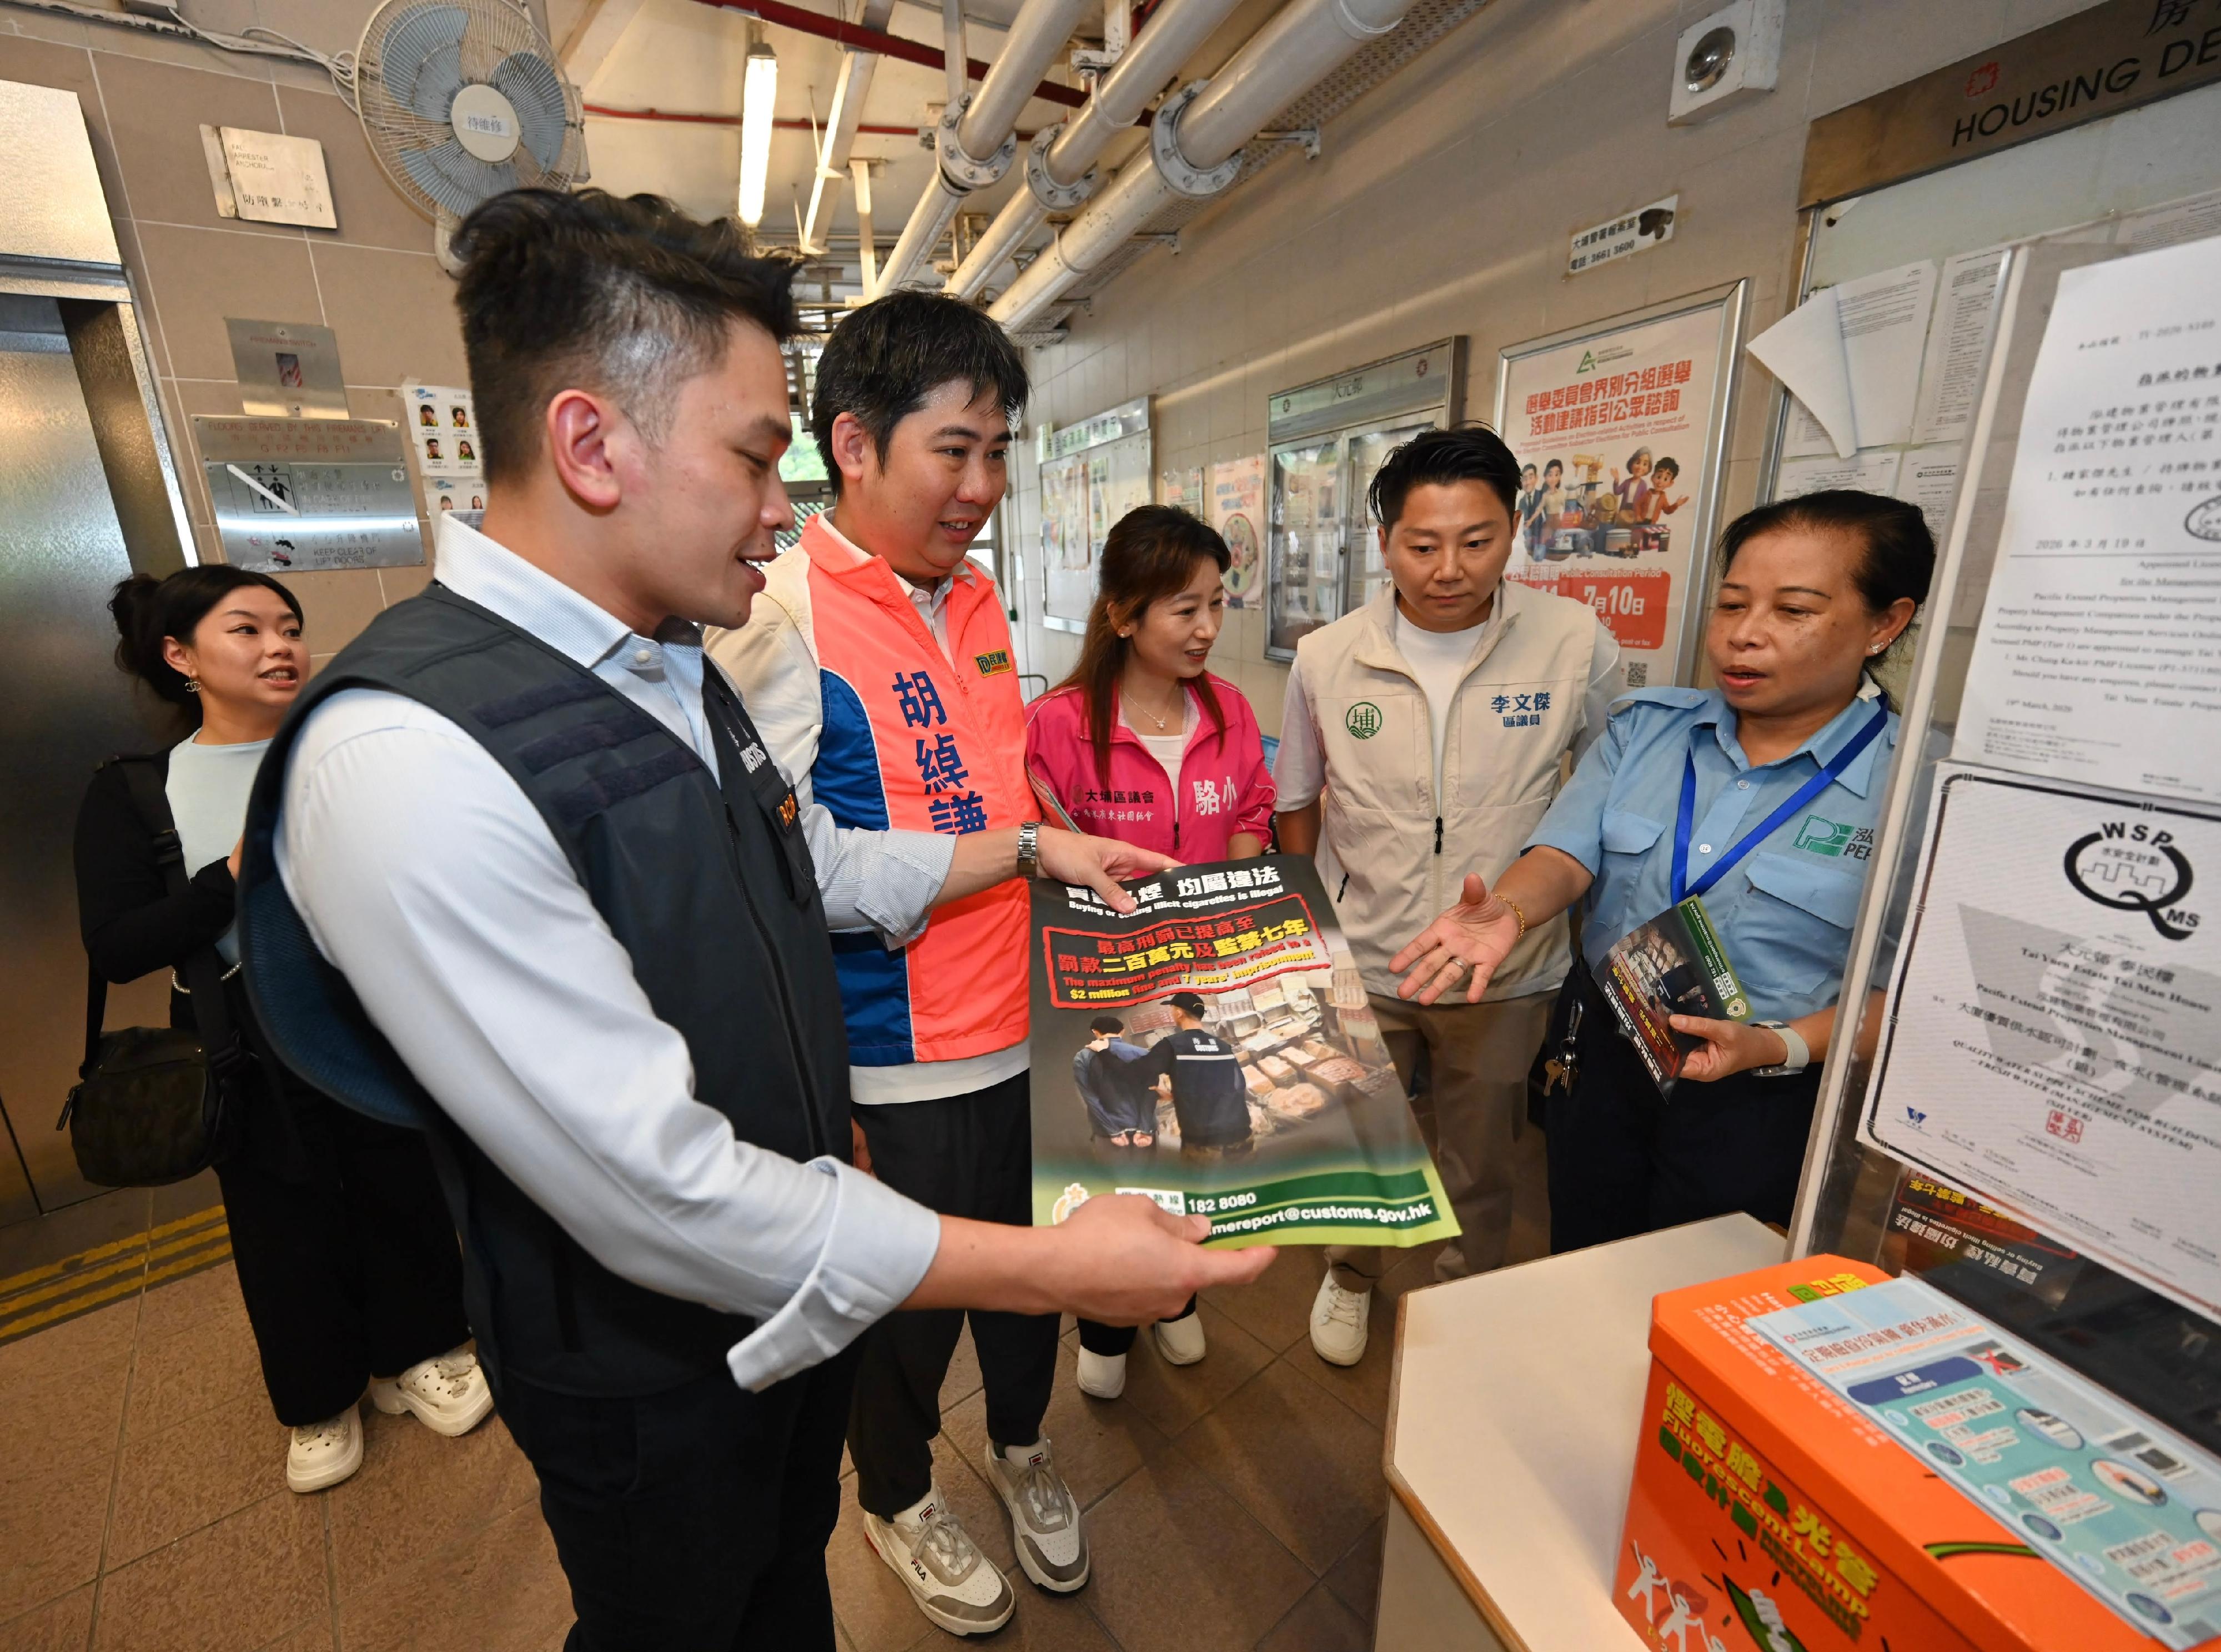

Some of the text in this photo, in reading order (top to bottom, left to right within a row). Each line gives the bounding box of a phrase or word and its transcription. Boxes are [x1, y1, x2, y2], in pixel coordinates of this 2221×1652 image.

[1952, 27, 2221, 148] HOUSING DE
[234, 153, 269, 162] ARRESTER
[1614, 239, 1635, 255] 3600
[1526, 359, 1692, 415] 選舉委員會界別分組選舉
[1530, 389, 1681, 436] 活動建議指引公眾諮詢
[208, 421, 387, 435] FLOORS SERVED BY THIS LIFT
[1631, 428, 1649, 438] Public
[1650, 421, 1691, 435] Consultation
[1584, 568, 1634, 579] Consultation
[1634, 566, 1663, 578] Period
[1584, 585, 1645, 616] 7月10日
[1490, 692, 1551, 714] 李文傑
[1503, 714, 1541, 727] 區議員
[1085, 789, 1154, 804] 大埔區議會
[1083, 809, 1155, 822] 香港廣東社團總會
[2102, 822, 2174, 846] WSP
[1066, 865, 1281, 906] 買煙 均屬違法
[1069, 901, 1103, 916] Buying
[1154, 899, 1181, 910] illicit
[1183, 893, 1237, 910] cigarettes
[1238, 892, 1248, 901] is
[1249, 884, 1284, 899] illegal
[2165, 908, 2202, 928] MS
[1057, 918, 1309, 975] 罰款二百萬元及監禁七年
[1097, 915, 1257, 956] 最高刑罰已提高至
[1689, 902, 1728, 973] crimereport@customs.gov.hk
[1063, 938, 1312, 988] The maximum penalty has been raised to a
[1070, 950, 1315, 1001] $2 million fine and 7 years' imprisonment
[1976, 982, 2008, 1000] Pacific
[2011, 995, 2046, 1013] Extend
[2107, 1027, 2184, 1061] Management
[1188, 1199, 1216, 1213] 182
[1219, 1192, 1257, 1211] 8080
[1662, 1408, 1792, 1543] Fluorescent
[1793, 1537, 1871, 1621] Lamp
[911, 1559, 927, 1581] FILA
